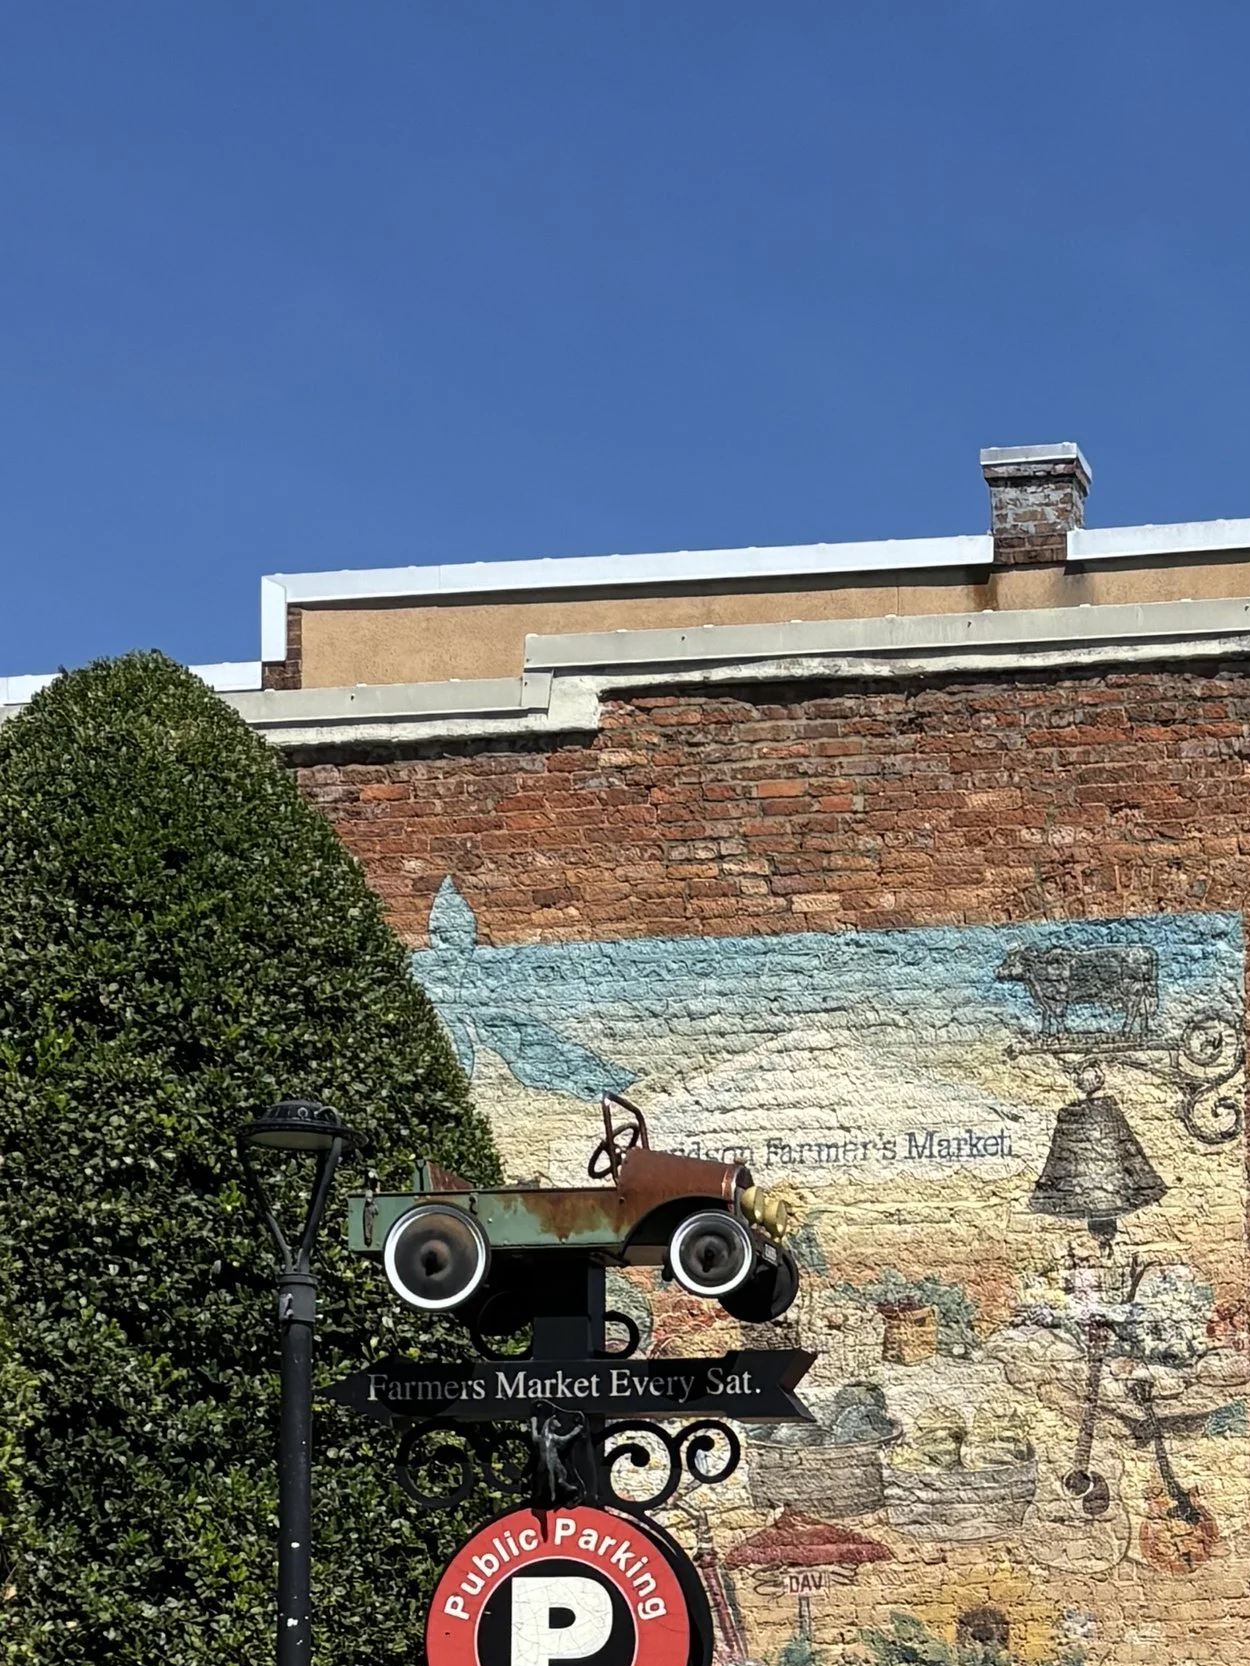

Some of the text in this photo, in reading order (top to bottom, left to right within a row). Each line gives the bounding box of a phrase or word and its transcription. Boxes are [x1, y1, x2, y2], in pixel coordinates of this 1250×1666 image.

[765, 1133, 897, 1165] Farmer's
[905, 1128, 1013, 1160] Market
[367, 1367, 762, 1403] Farmers Market Every Sat.
[444, 1518, 668, 1621] Public Parking
